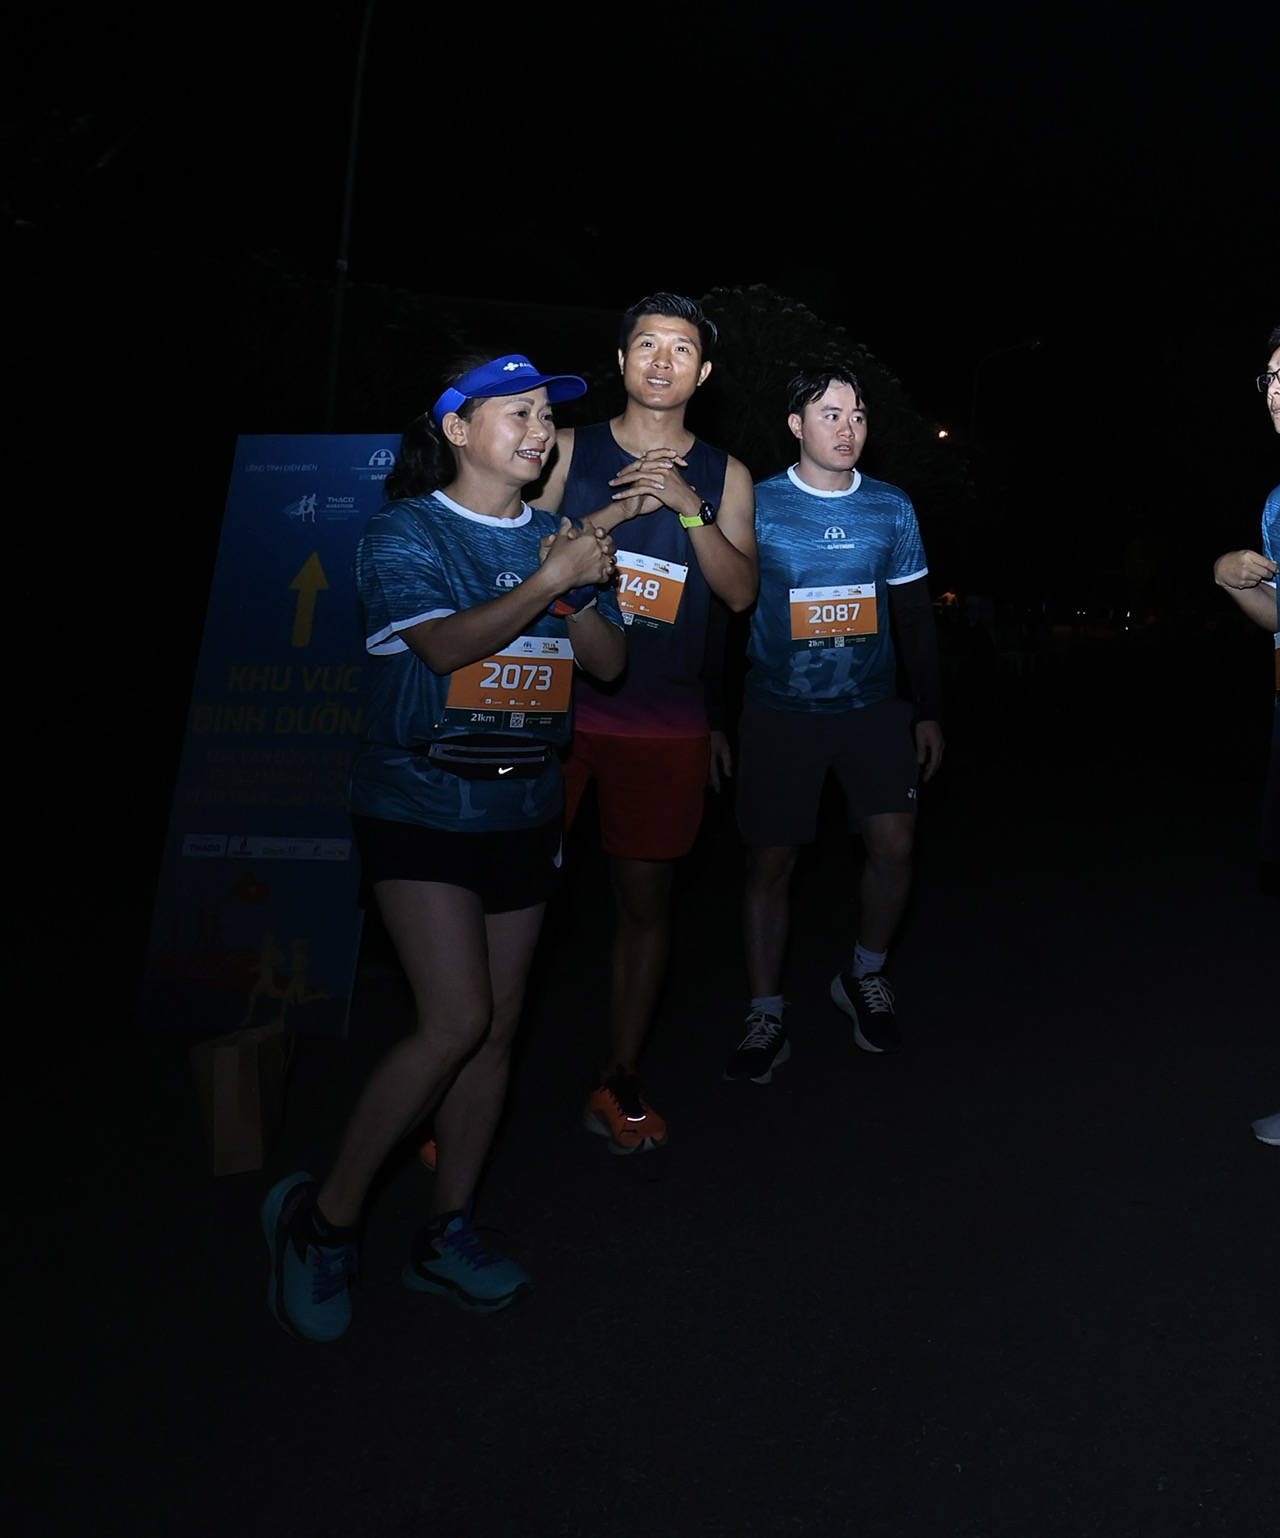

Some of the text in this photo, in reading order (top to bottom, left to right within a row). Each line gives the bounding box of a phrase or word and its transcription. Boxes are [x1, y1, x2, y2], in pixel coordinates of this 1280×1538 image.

[619, 573, 660, 600] 148
[808, 603, 860, 624] 2087
[228, 665, 292, 693] KHU
[480, 662, 553, 691] 2073
[192, 701, 363, 735] DINH DƯỠN
[470, 713, 495, 723] 21km
